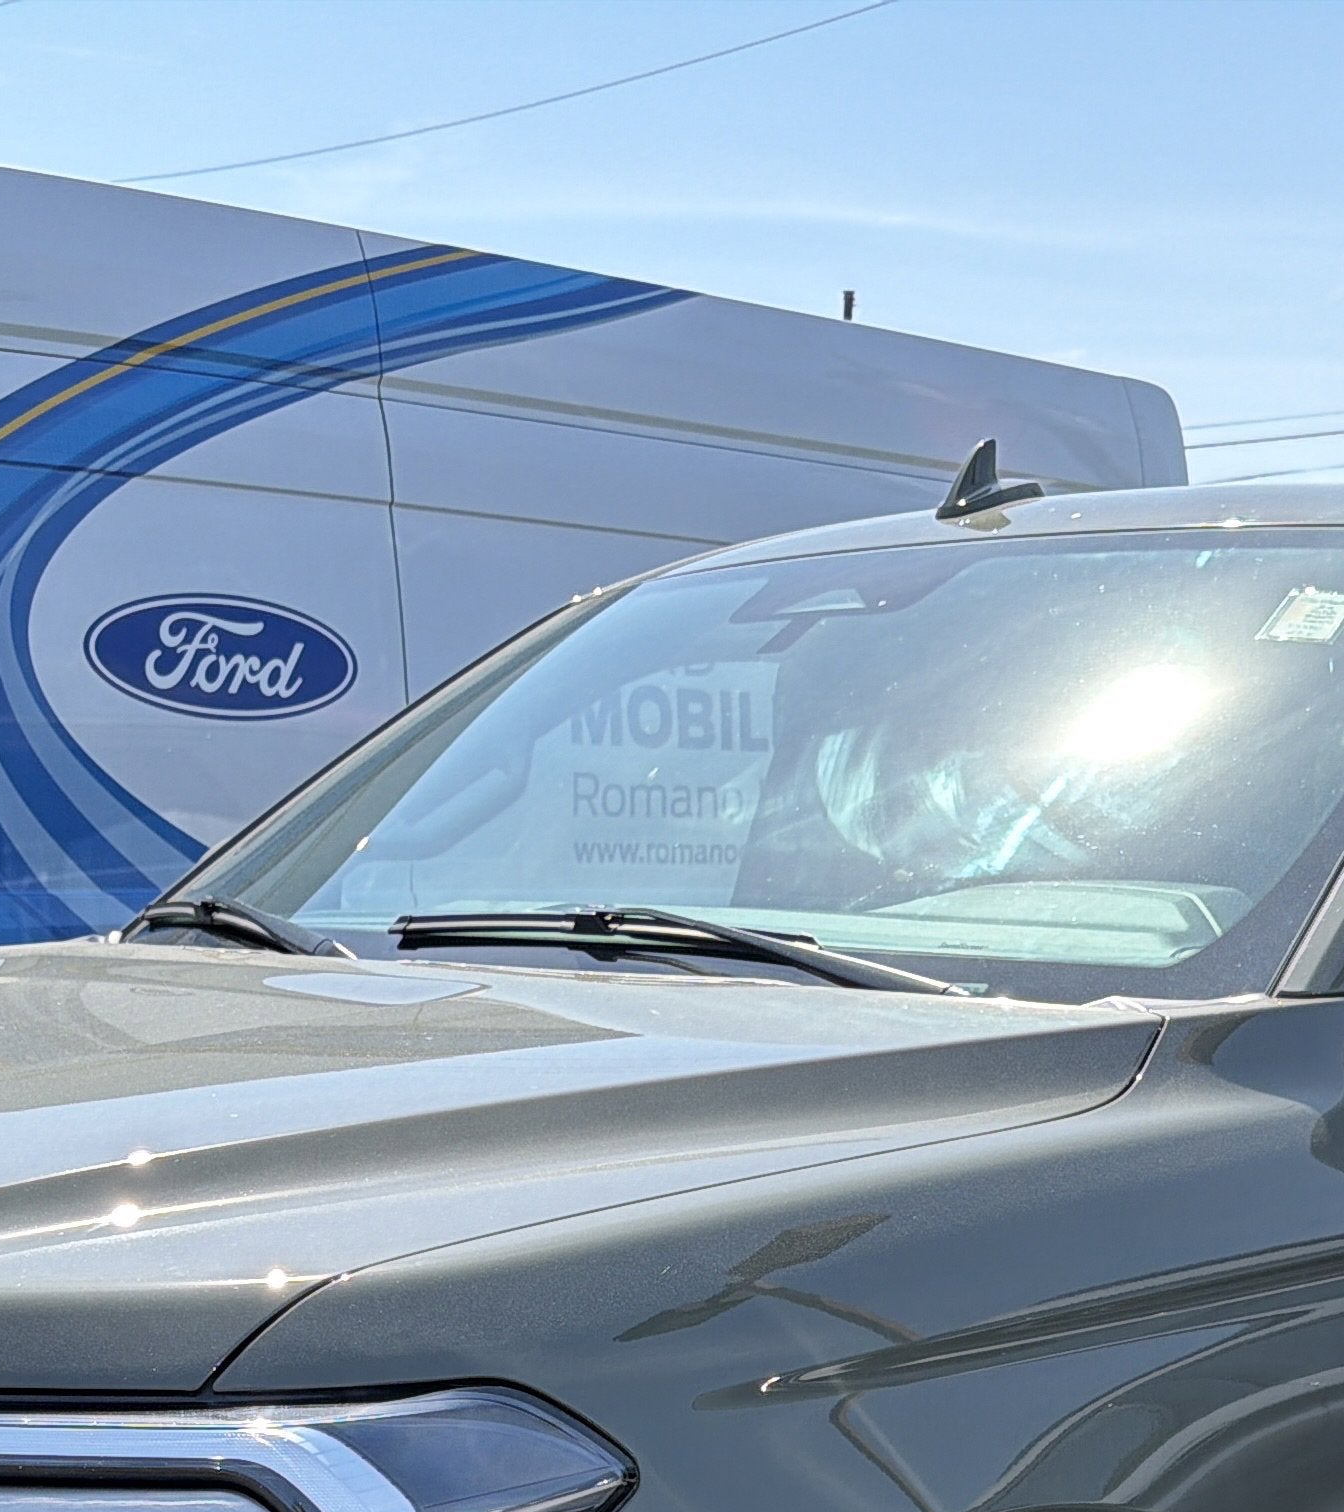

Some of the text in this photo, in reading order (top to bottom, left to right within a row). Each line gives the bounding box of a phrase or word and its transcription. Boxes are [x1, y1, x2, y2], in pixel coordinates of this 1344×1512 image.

[144, 611, 305, 699] Ford
[569, 684, 769, 752] MOBIL
[571, 771, 744, 819] Romano
